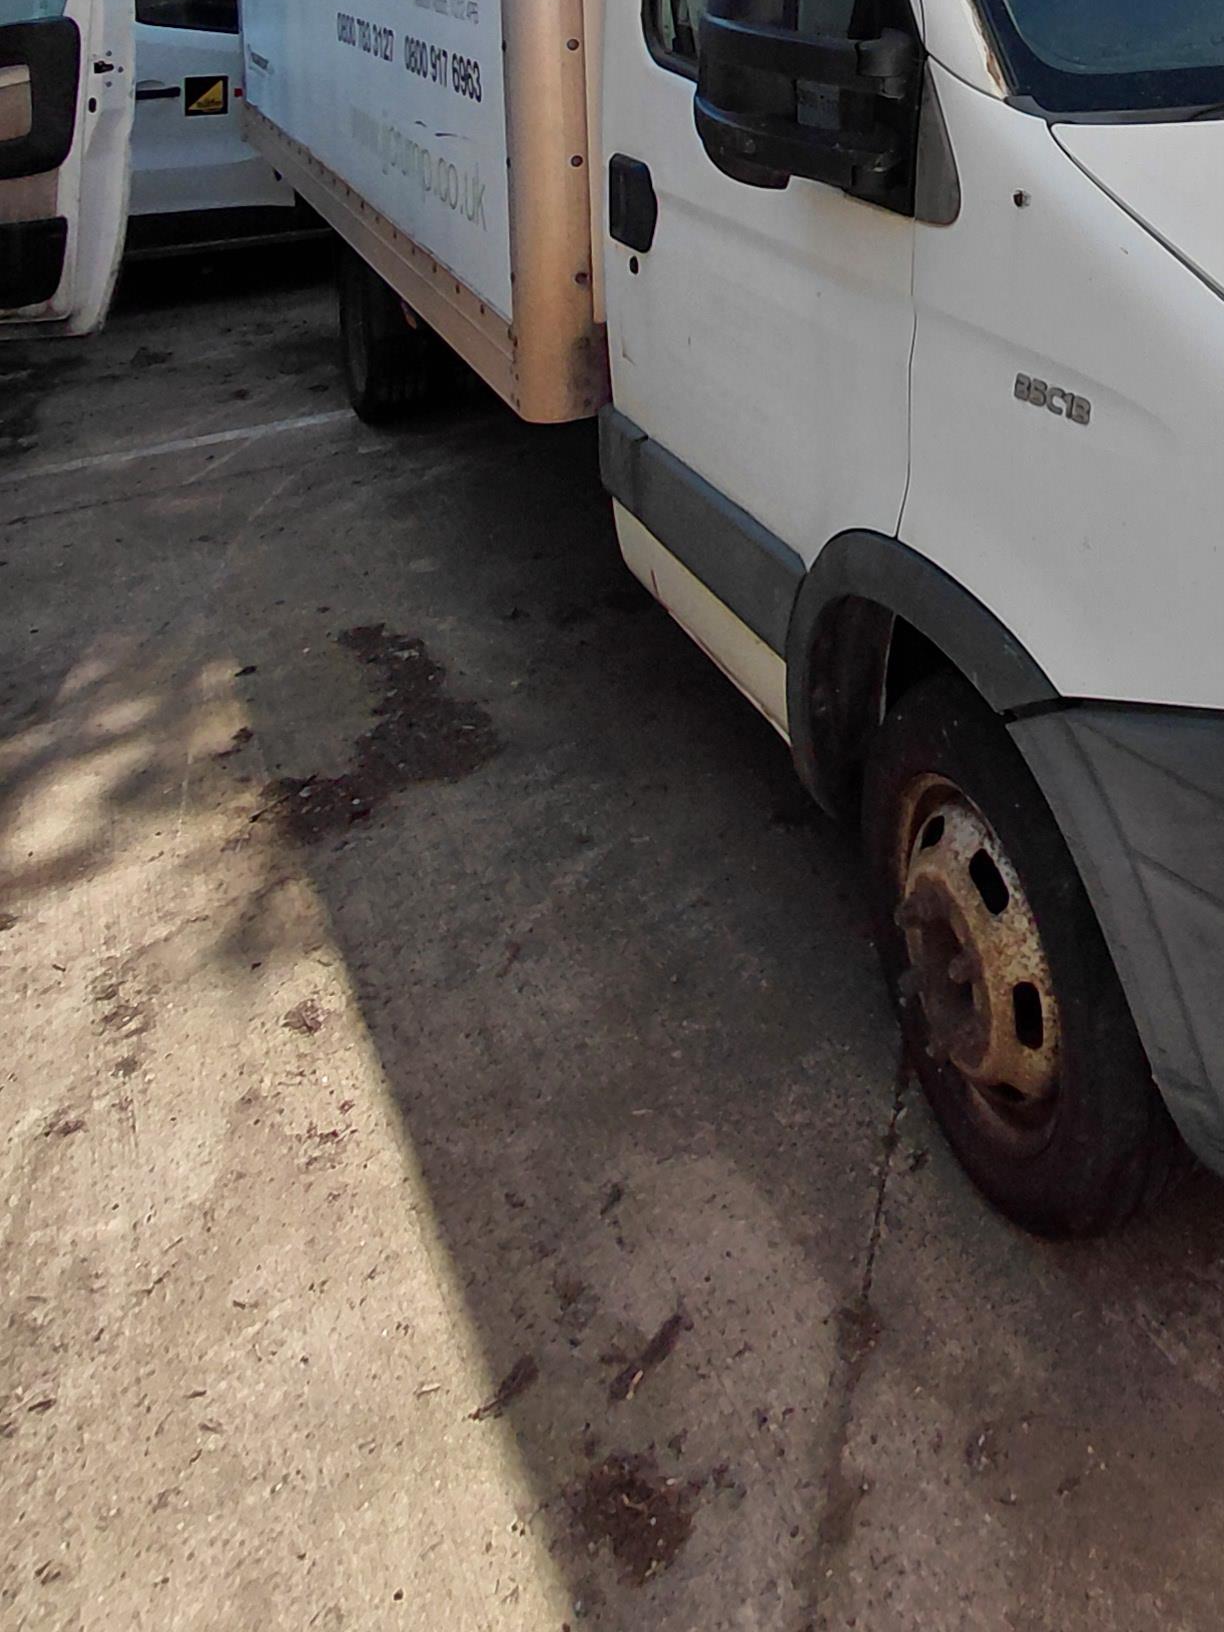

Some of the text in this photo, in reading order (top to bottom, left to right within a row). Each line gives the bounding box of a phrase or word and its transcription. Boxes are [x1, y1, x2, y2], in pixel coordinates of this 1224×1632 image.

[404, 35, 482, 103] 0800 917 6963
